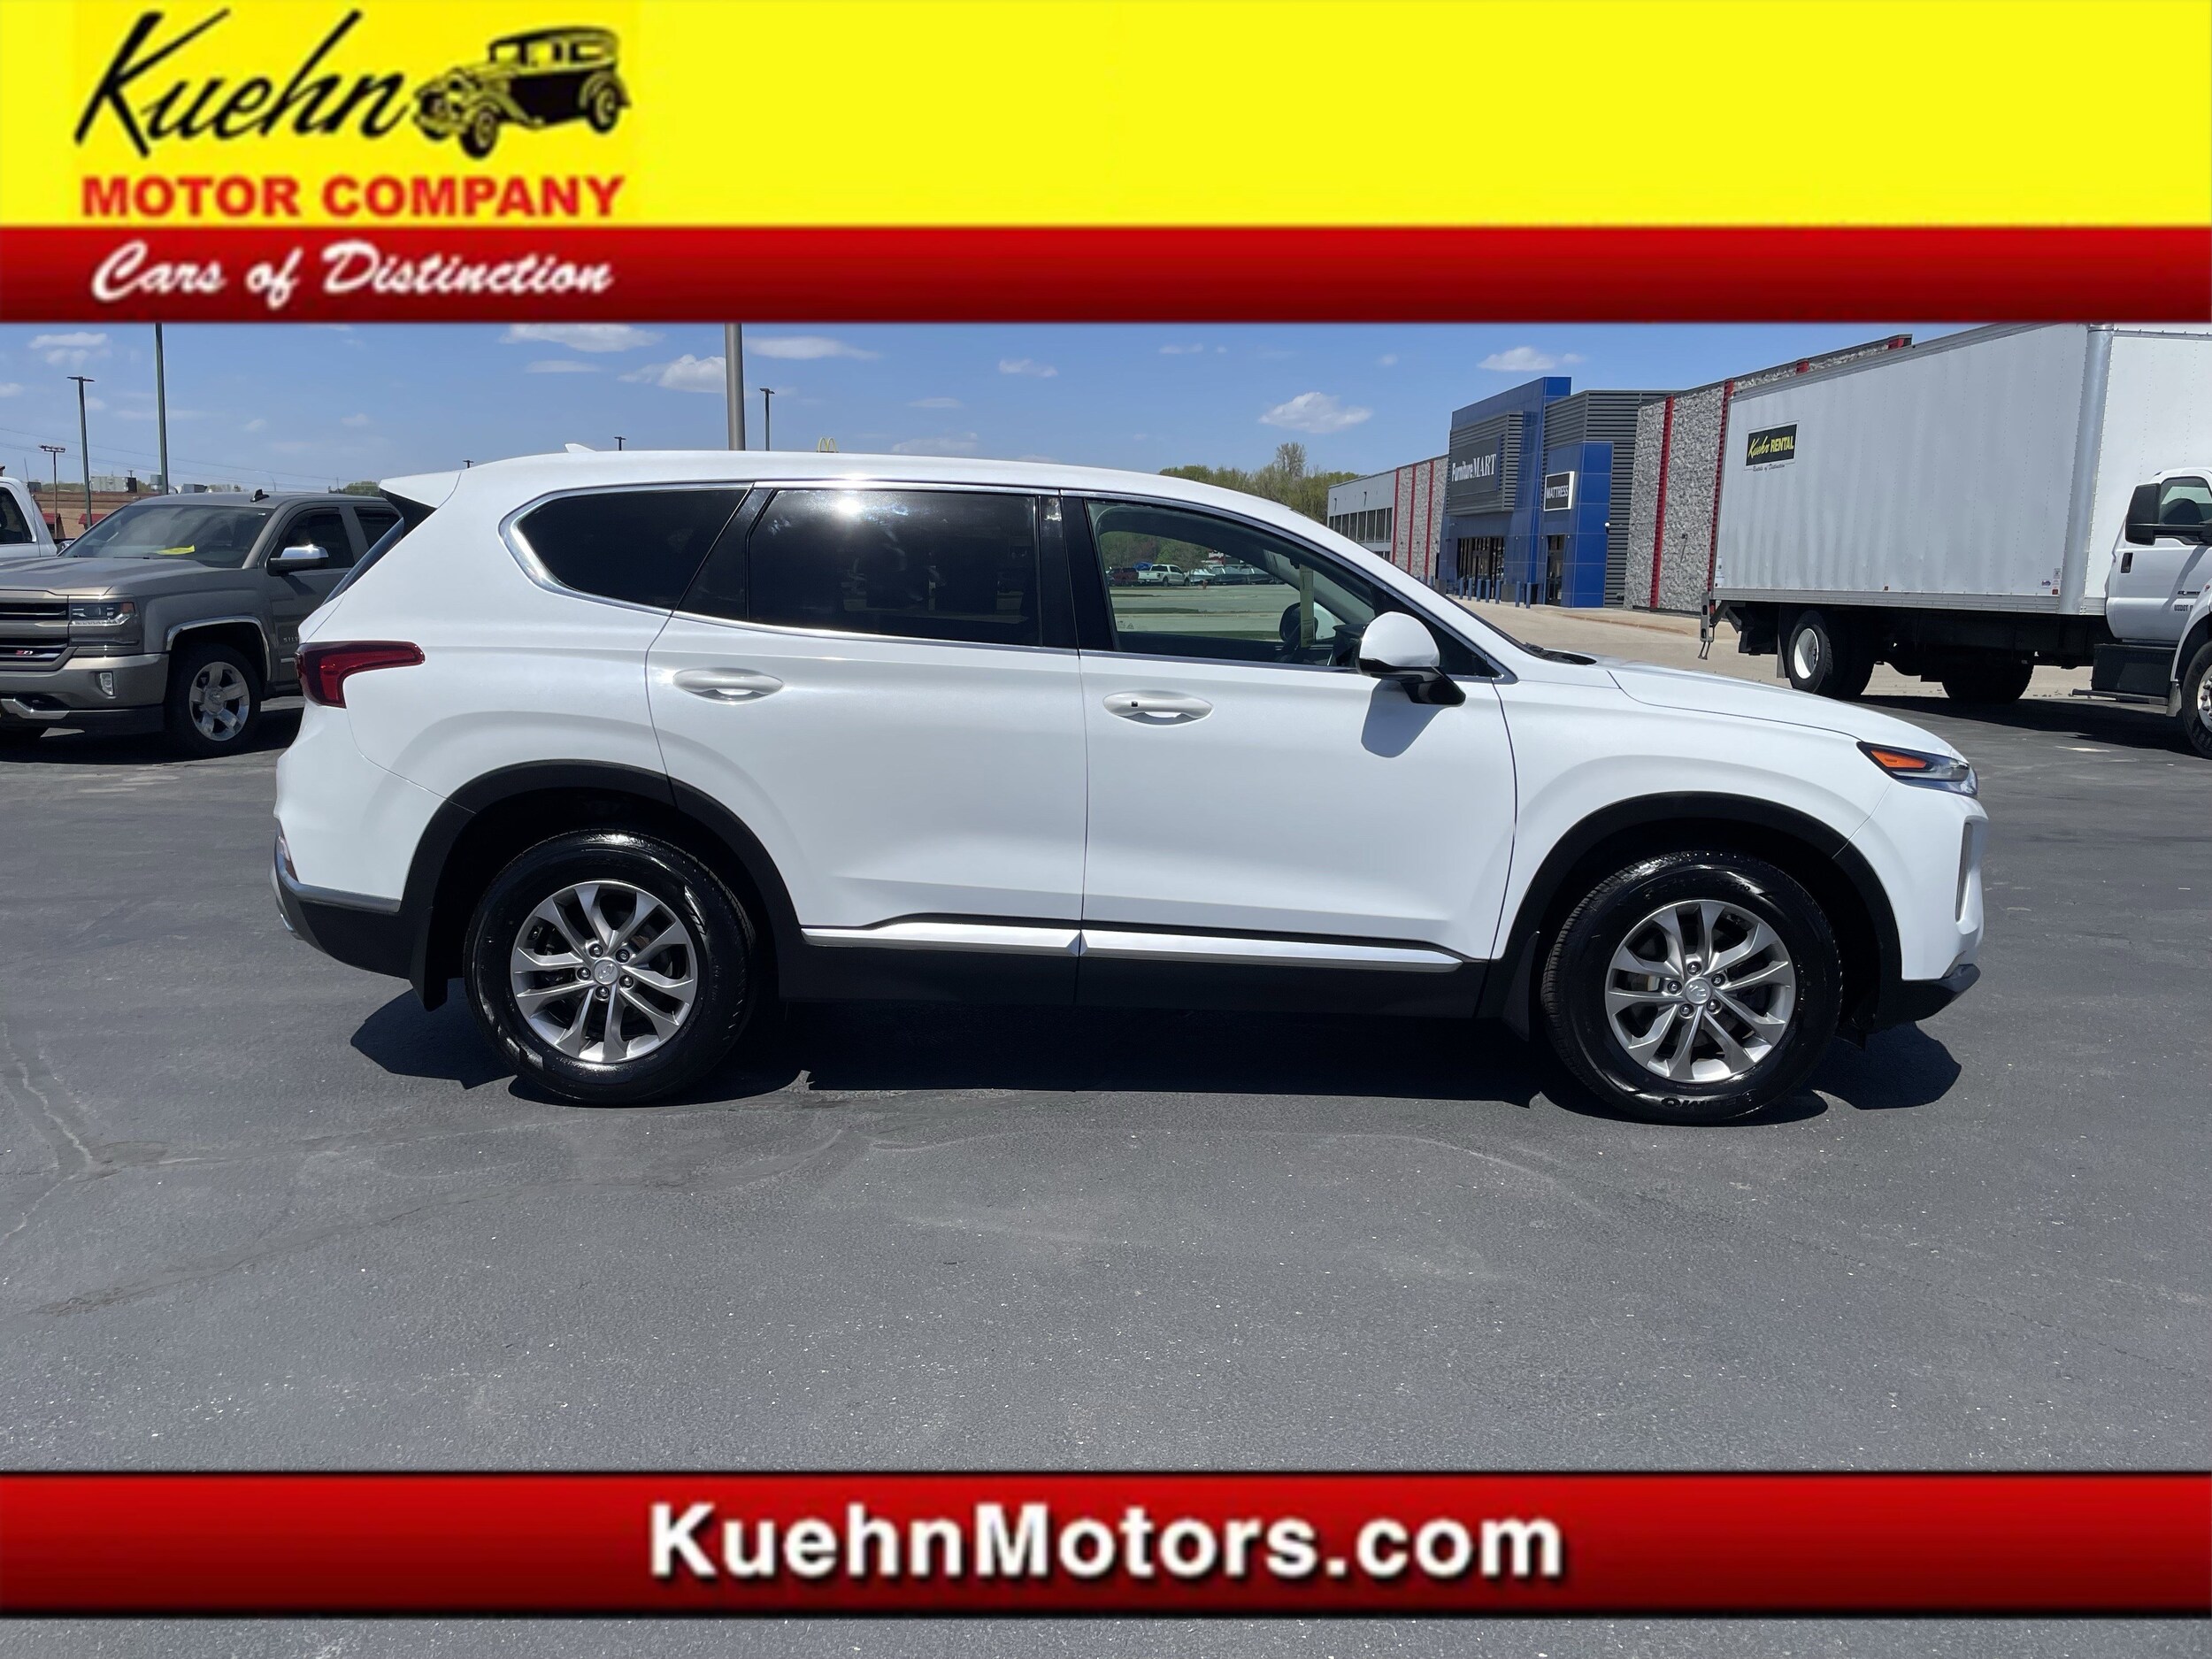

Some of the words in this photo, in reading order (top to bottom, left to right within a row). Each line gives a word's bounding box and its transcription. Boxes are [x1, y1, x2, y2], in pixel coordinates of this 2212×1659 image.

[1747, 435, 1770, 458] Kuehn
[1770, 435, 1793, 453] RENTAL
[1546, 485, 1569, 499] MATTRESS
